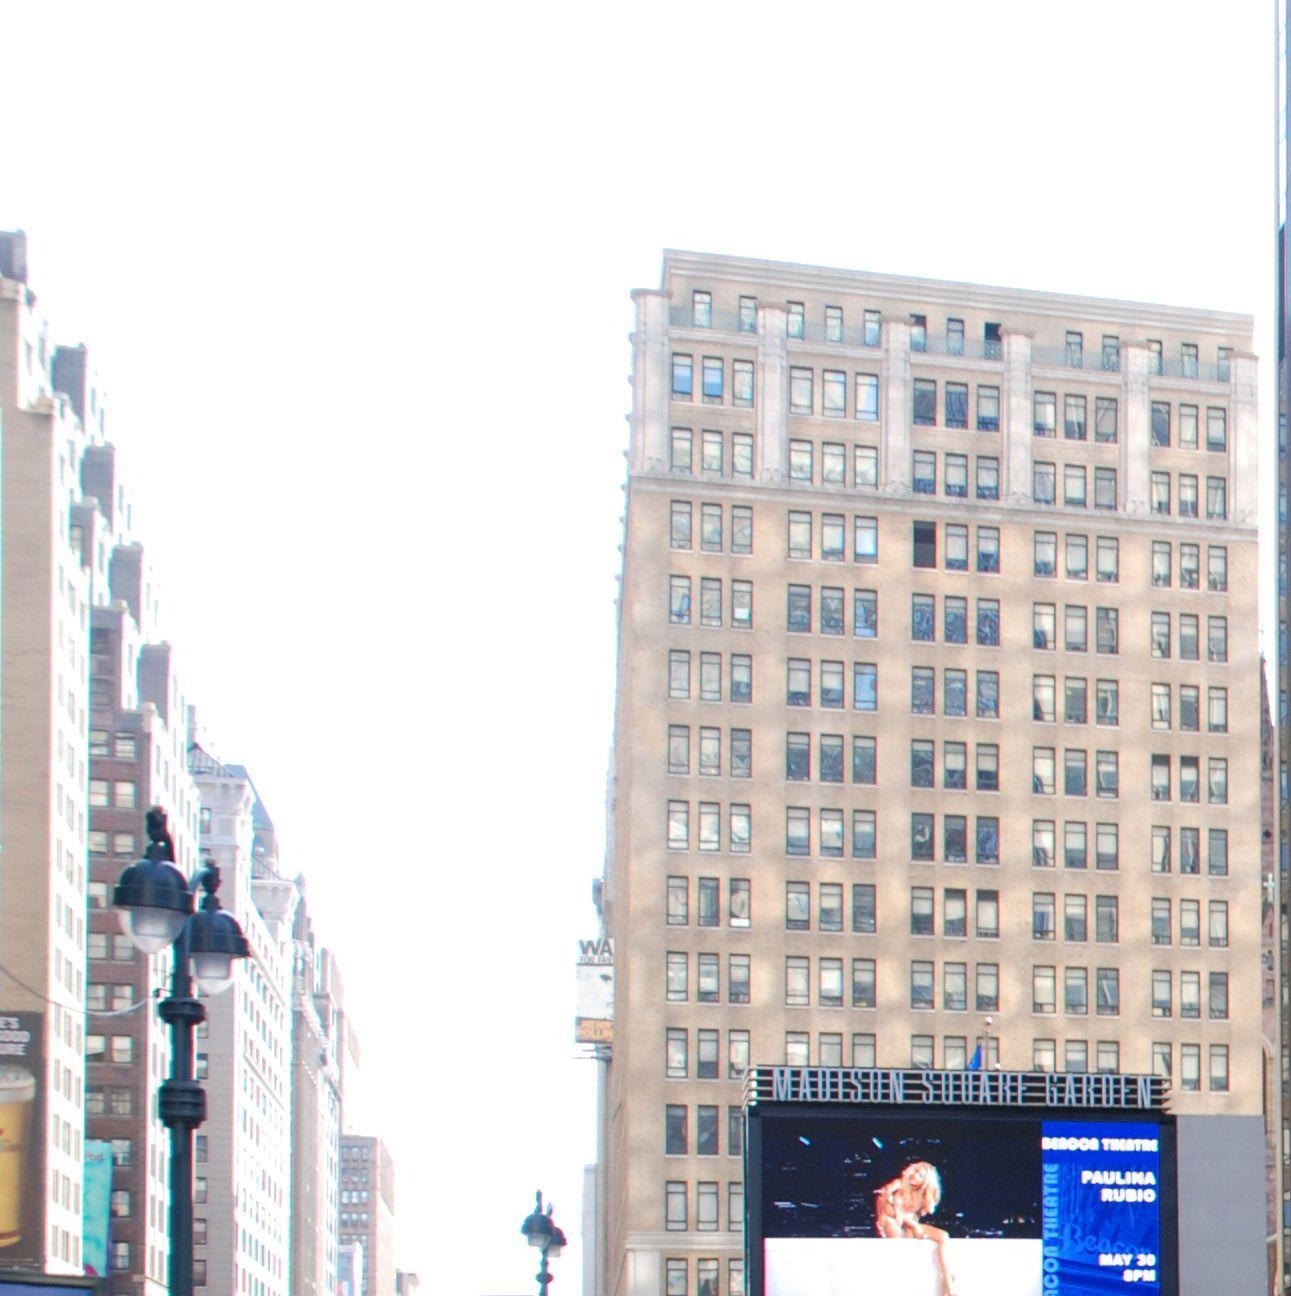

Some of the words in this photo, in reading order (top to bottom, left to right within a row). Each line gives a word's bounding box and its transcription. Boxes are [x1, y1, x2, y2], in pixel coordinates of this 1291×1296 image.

[772, 1067, 904, 1104] MADISON
[922, 1070, 1027, 1106] SQUARE
[1046, 1072, 1152, 1109] GARDEN
[1081, 1170, 1156, 1186] PAULINA
[1101, 1187, 1156, 1203] RUBIO
[1098, 1253, 1133, 1267] MAY
[1136, 1253, 1156, 1267] 30
